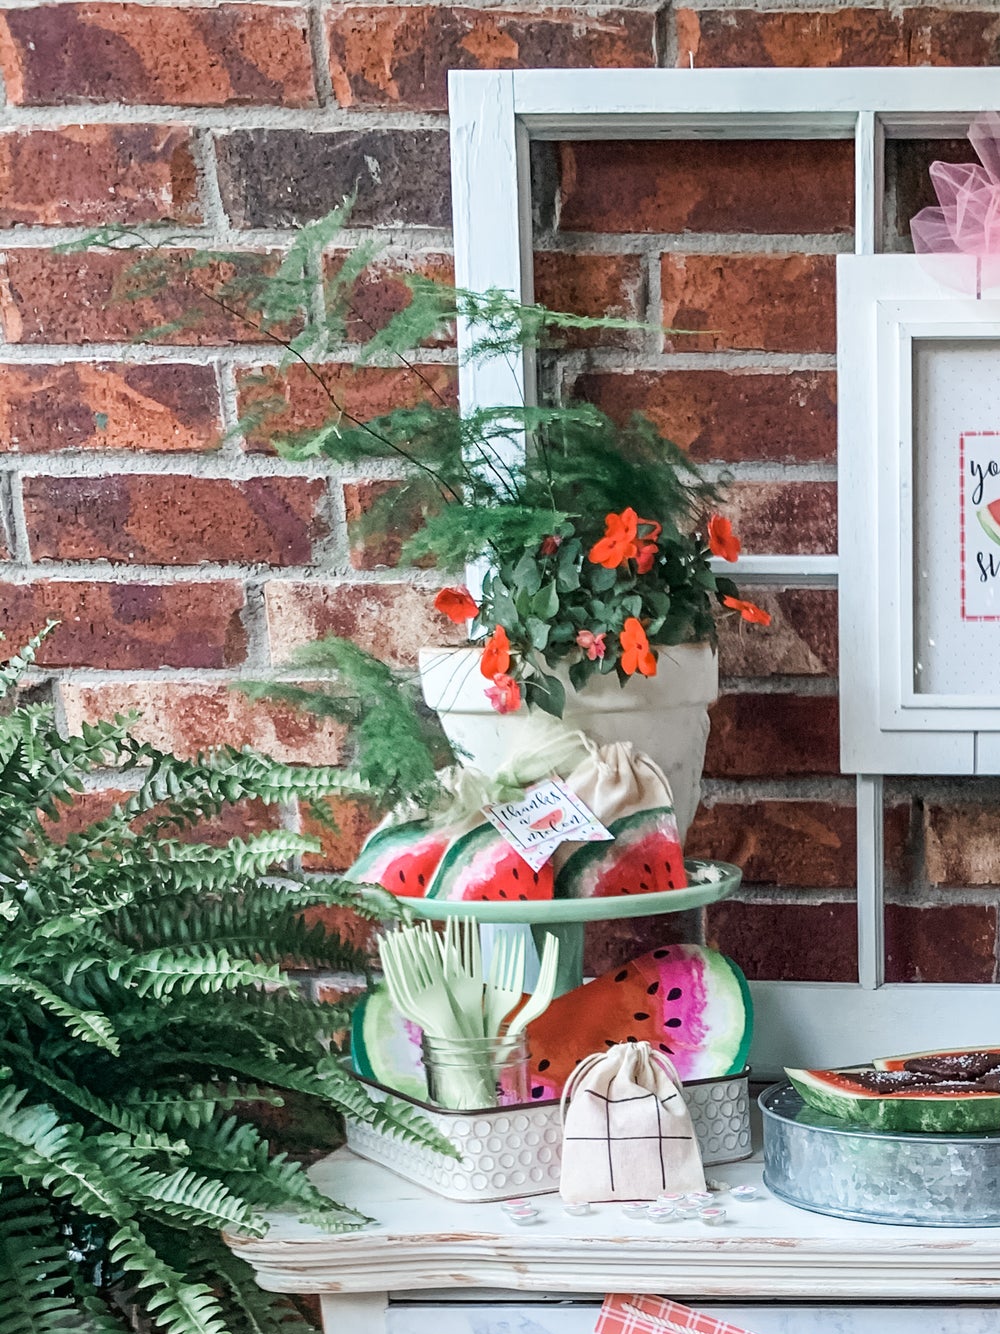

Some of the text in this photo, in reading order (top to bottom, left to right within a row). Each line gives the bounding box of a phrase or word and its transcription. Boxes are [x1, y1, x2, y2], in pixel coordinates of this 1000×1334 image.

[500, 791, 561, 821] thanks
[519, 816, 531, 826] a
[527, 815, 580, 842] melon
